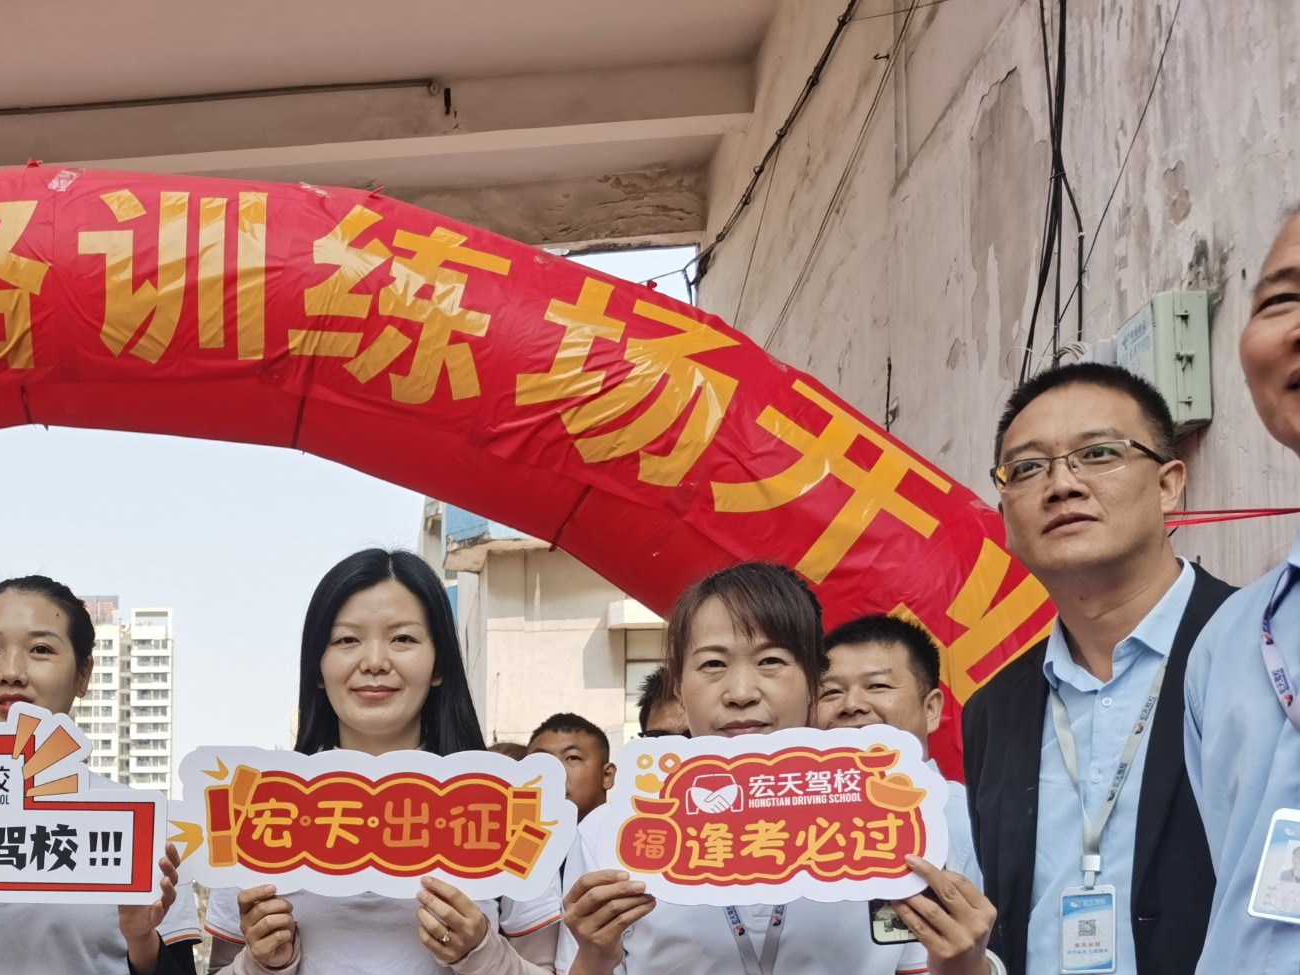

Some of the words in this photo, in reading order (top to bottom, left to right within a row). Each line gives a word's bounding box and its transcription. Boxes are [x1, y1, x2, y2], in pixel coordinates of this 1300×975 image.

[748, 768, 862, 797] 宏天驾校
[748, 796, 791, 808] HONGTIAN
[792, 795, 827, 806] DRIVING
[828, 792, 862, 803] SCHOOL
[632, 829, 668, 859] 福
[686, 813, 904, 869] 逢考必过
